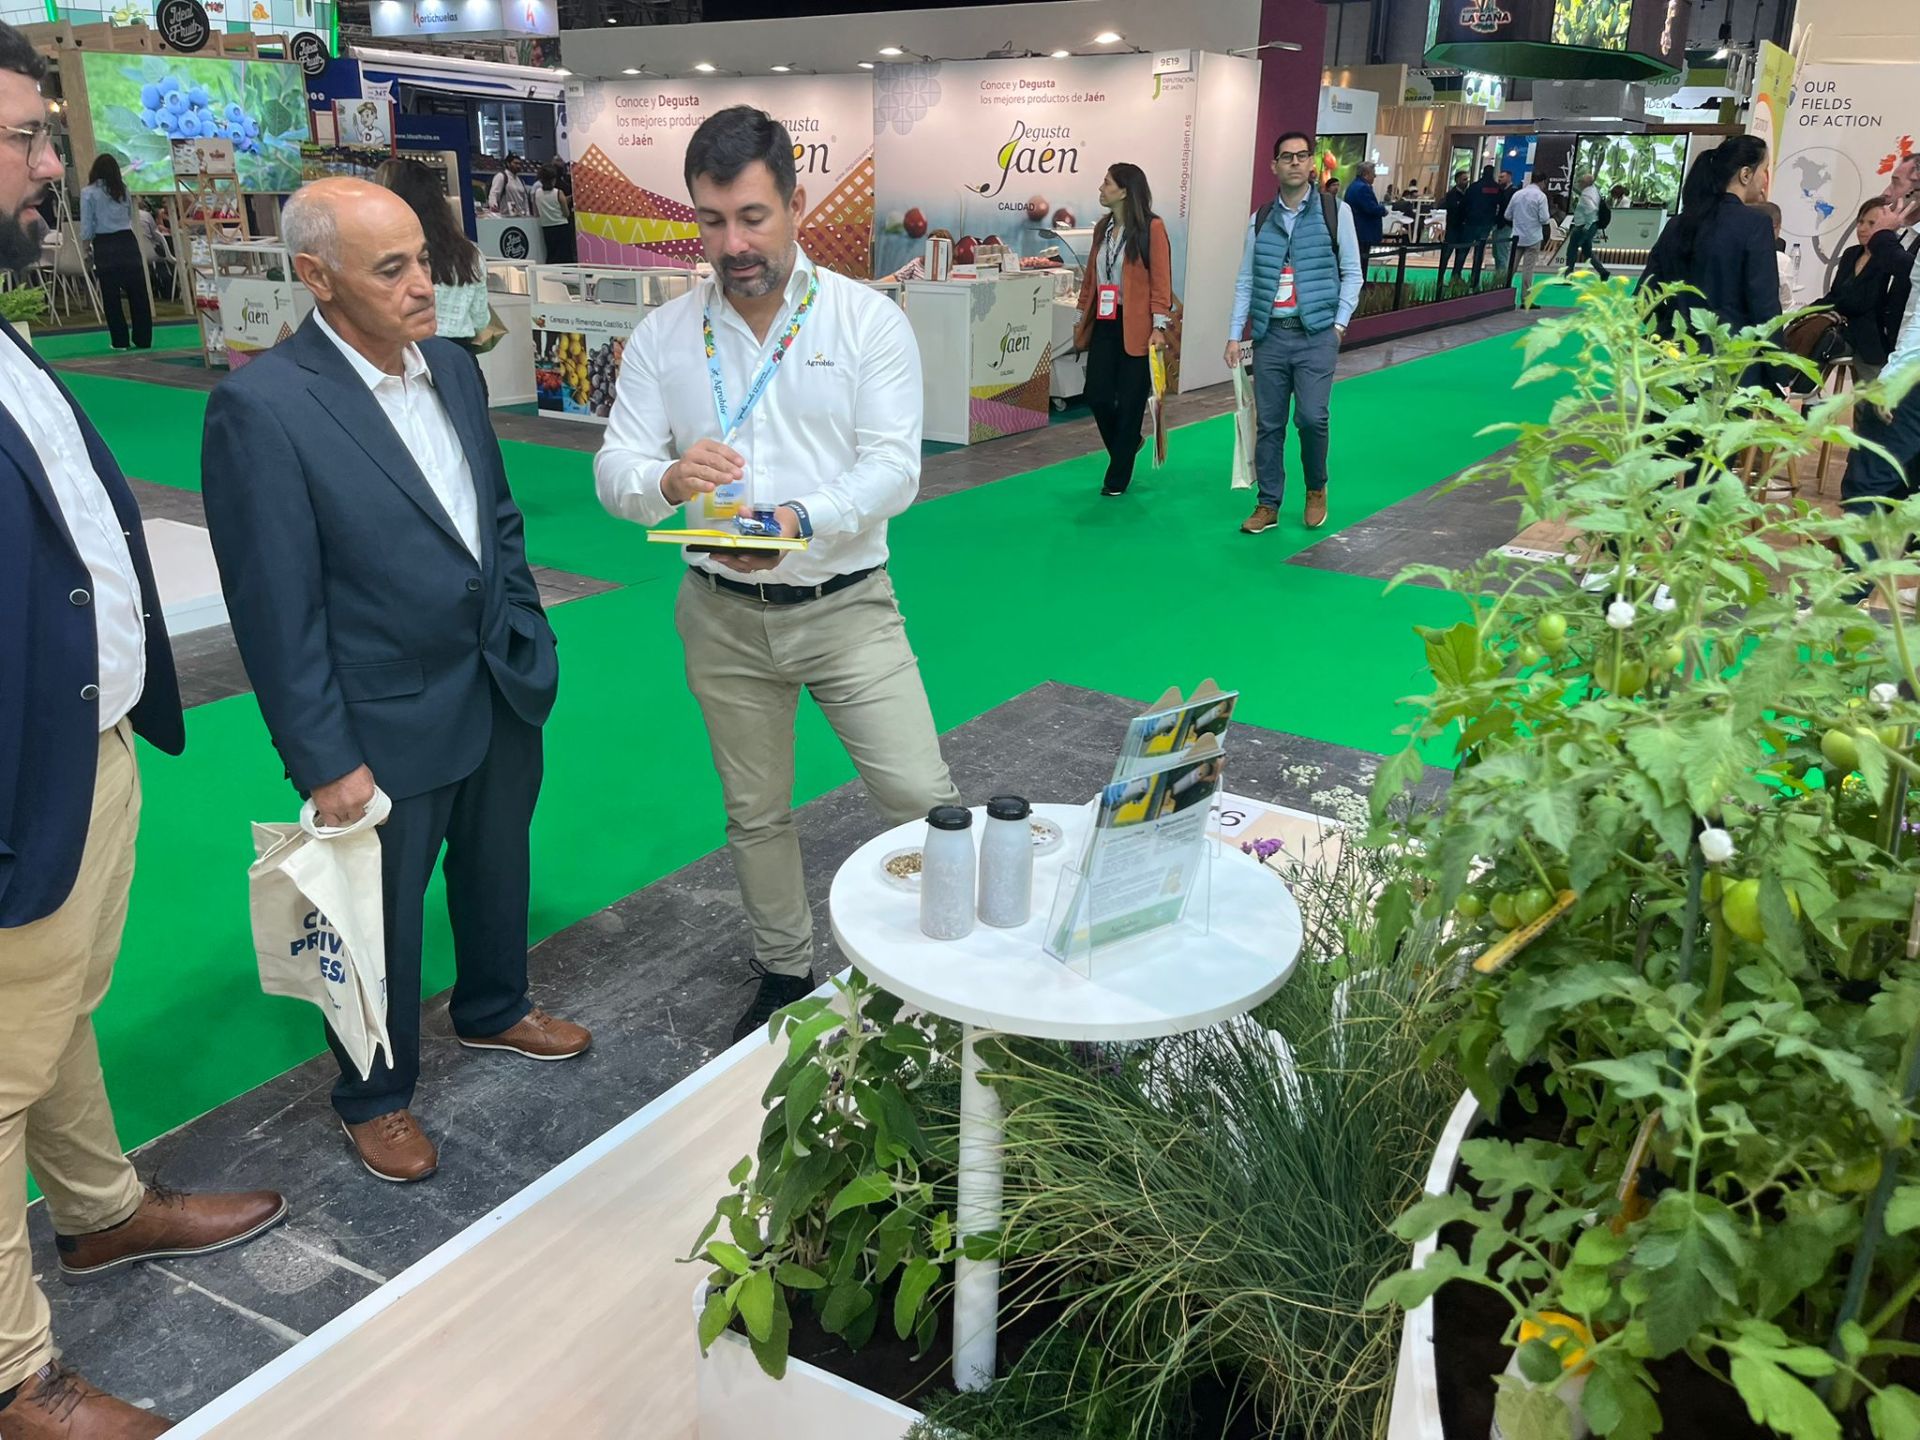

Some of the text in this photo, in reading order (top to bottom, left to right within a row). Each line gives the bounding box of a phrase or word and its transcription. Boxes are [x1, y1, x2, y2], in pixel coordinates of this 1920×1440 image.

[1160, 57, 1180, 67] 9E19
[980, 79, 1056, 91] Conoce y Degusta
[1804, 81, 1836, 93] OUR
[615, 94, 700, 110] Conoce y Degusta
[980, 92, 1105, 106] los mejores productos de Jaén
[1801, 98, 1852, 110] FIELDS
[616, 115, 629, 127] los
[631, 115, 667, 130] mejores
[1799, 114, 1882, 127] OF ACTION
[1008, 120, 1071, 142] Degusta
[618, 133, 654, 146] de Jaén
[1179, 114, 1191, 218] www.degustajaen.es
[1548, 182, 1562, 191] LA
[998, 202, 1035, 211] CALIDAD
[291, 930, 345, 957] PRIV
